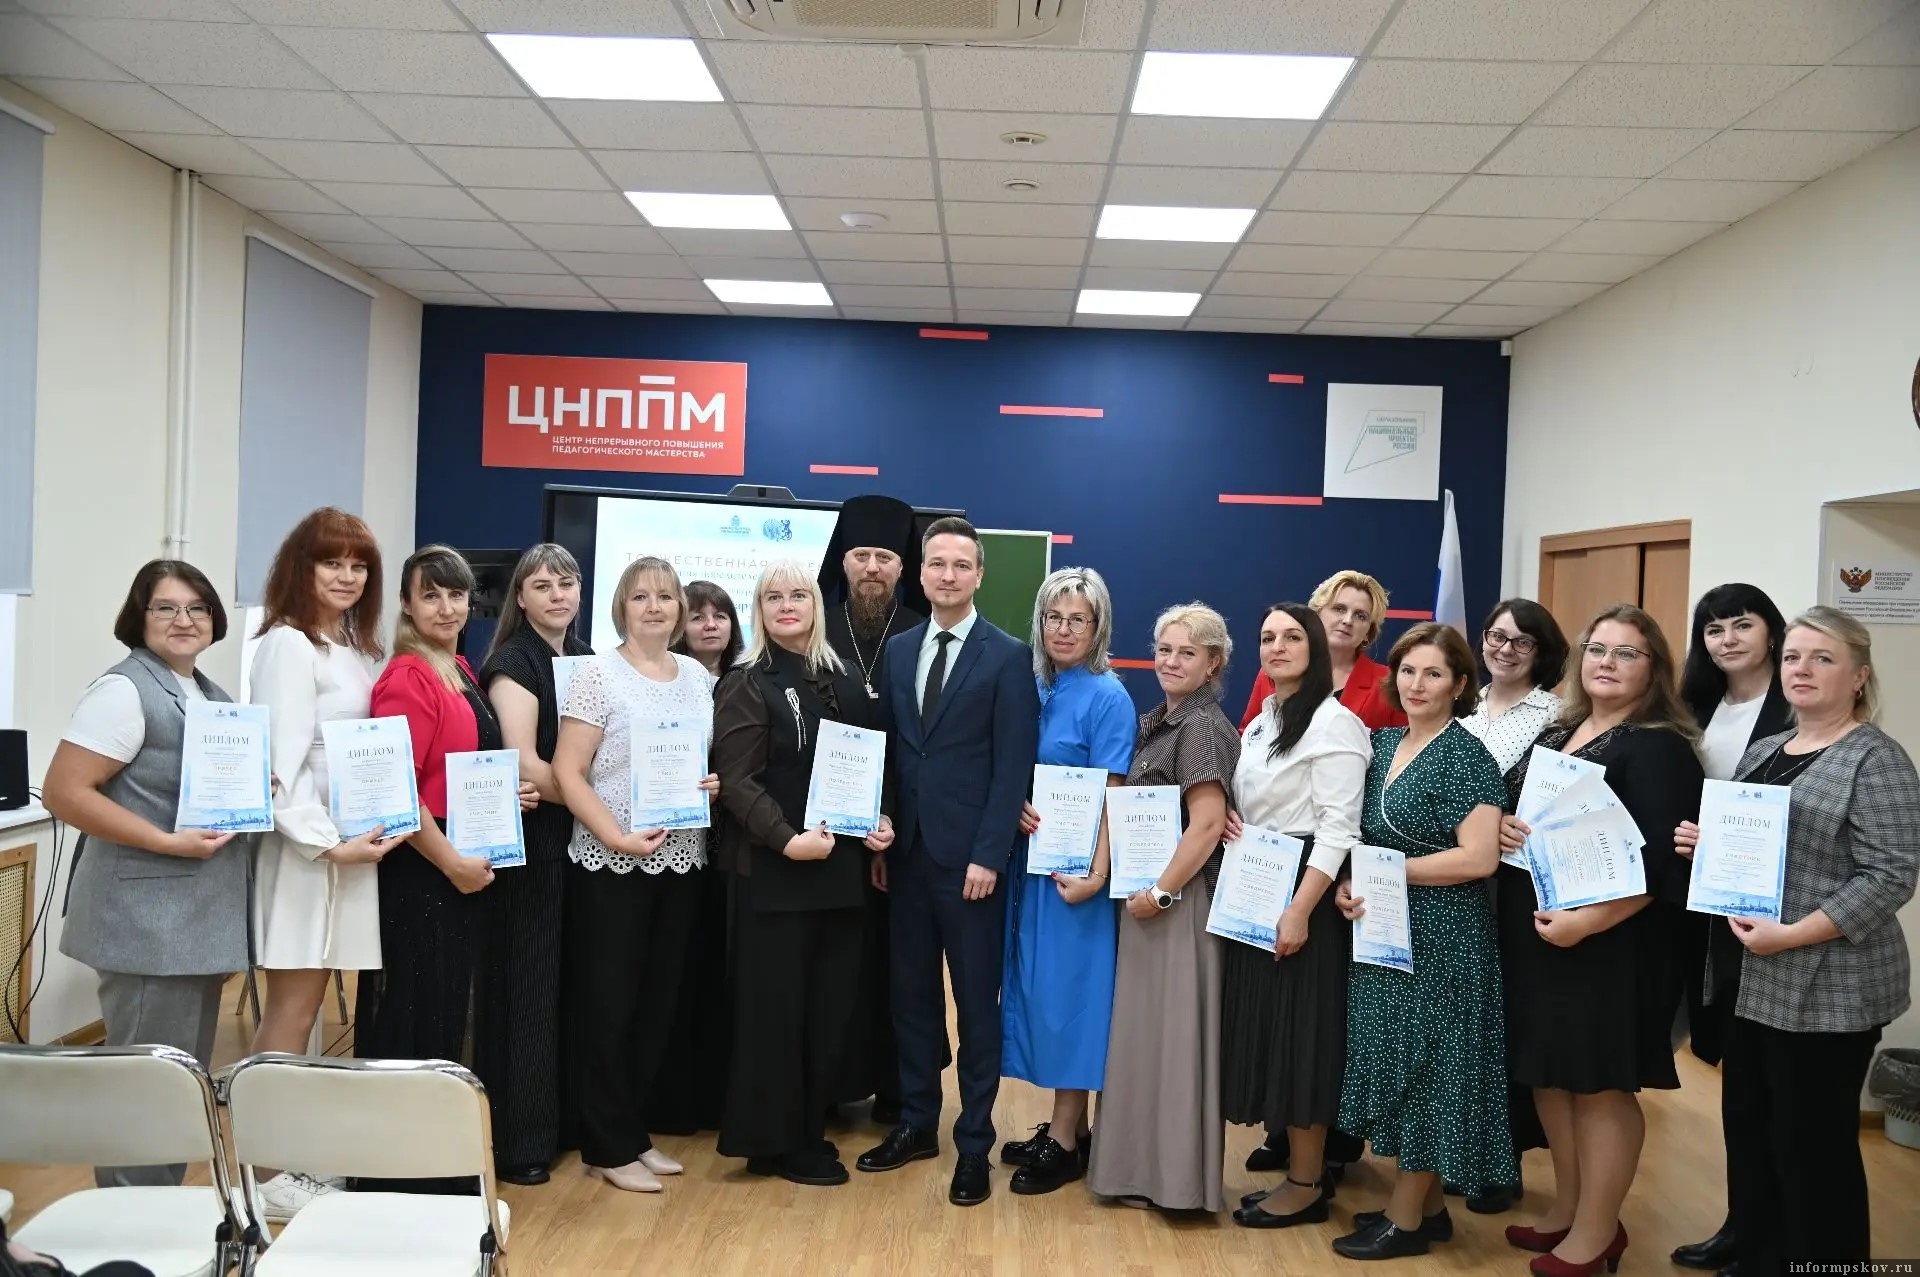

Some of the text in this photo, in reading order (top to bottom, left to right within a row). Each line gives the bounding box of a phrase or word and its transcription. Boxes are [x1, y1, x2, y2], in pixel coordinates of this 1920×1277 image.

[552, 436, 724, 449] ЦЕНТР НЕПРЕРЫВНОГО ПОВЫШЕНИЯ
[552, 445, 705, 459] ПЕДАГОГИЧЕСКОГО МАСТЕРСТВА
[201, 734, 249, 745] ДИПЛОМ
[346, 747, 394, 759] ДИПЛОМ
[646, 744, 690, 754] ДИПЛОМ
[463, 779, 503, 791] ДИПЛОМ
[1049, 792, 1091, 803] ДИПЛОМ
[1124, 814, 1166, 824] ДИПЛОМ
[1720, 815, 1771, 829] ДИПЛОМ
